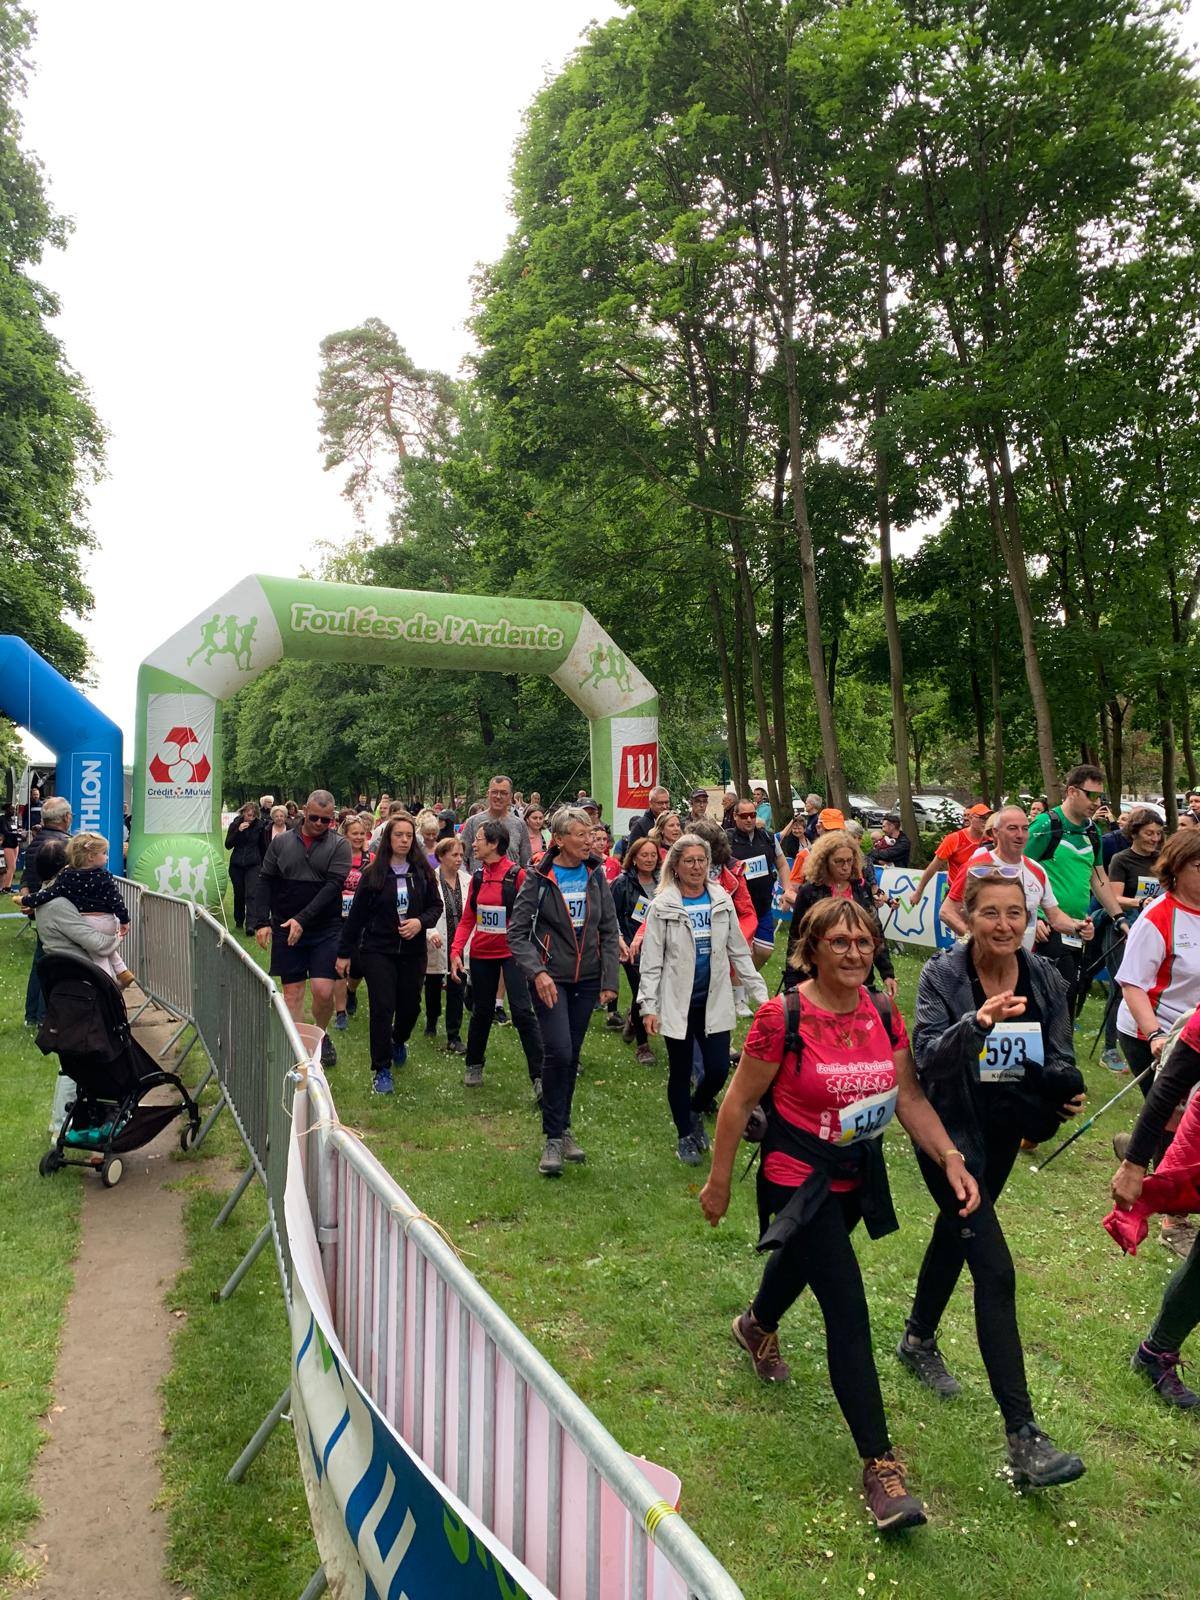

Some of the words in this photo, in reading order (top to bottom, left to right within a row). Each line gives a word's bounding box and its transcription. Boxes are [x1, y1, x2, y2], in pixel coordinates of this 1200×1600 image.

[293, 605, 401, 637] Foulées
[405, 614, 440, 640] de
[443, 616, 562, 648] l'Ardente
[627, 754, 653, 789] LU
[147, 788, 173, 796] Crédit
[748, 860, 762, 873] 577
[1143, 883, 1161, 895] 587
[568, 900, 587, 918] 57
[481, 911, 499, 926] 550
[688, 912, 712, 928] 534
[985, 1037, 1026, 1066] 593
[854, 1106, 886, 1135] 542
